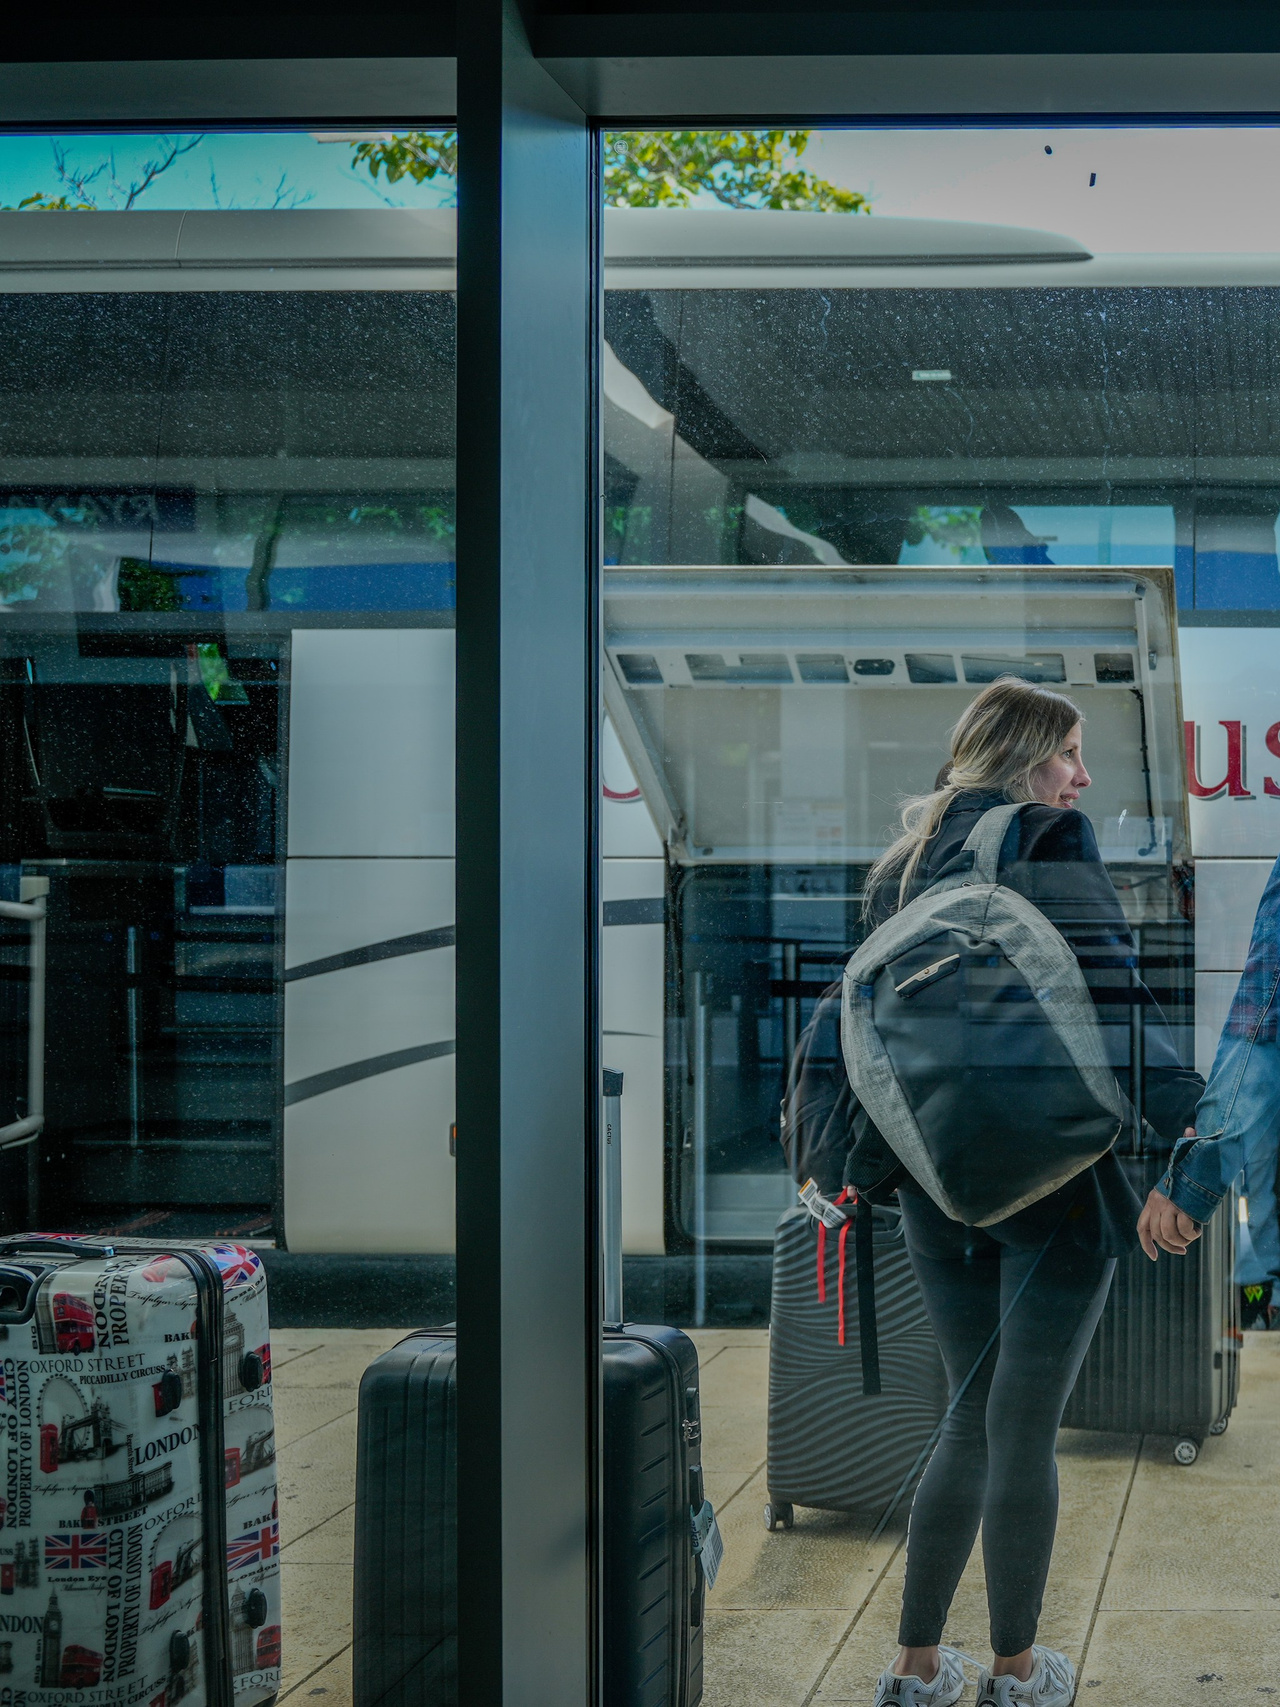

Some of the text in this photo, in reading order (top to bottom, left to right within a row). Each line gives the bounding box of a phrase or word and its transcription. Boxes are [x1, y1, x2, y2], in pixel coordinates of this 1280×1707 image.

[30, 1353, 146, 1374] OXFORD STREET
[79, 1364, 166, 1385] PICCADILLY CIRCUSS
[4, 1358, 18, 1529] CITY OF LONDON
[16, 1360, 32, 1528] PROPERTY OF LONDON
[97, 1505, 149, 1527] STREET
[87, 1575, 107, 1583] Eye
[102, 1529, 124, 1682] CITY OF LONDON
[117, 1523, 143, 1680] PROPERTY OF LONDON
[27, 1690, 85, 1704] OXFORD
[88, 1675, 149, 1703] STREET
